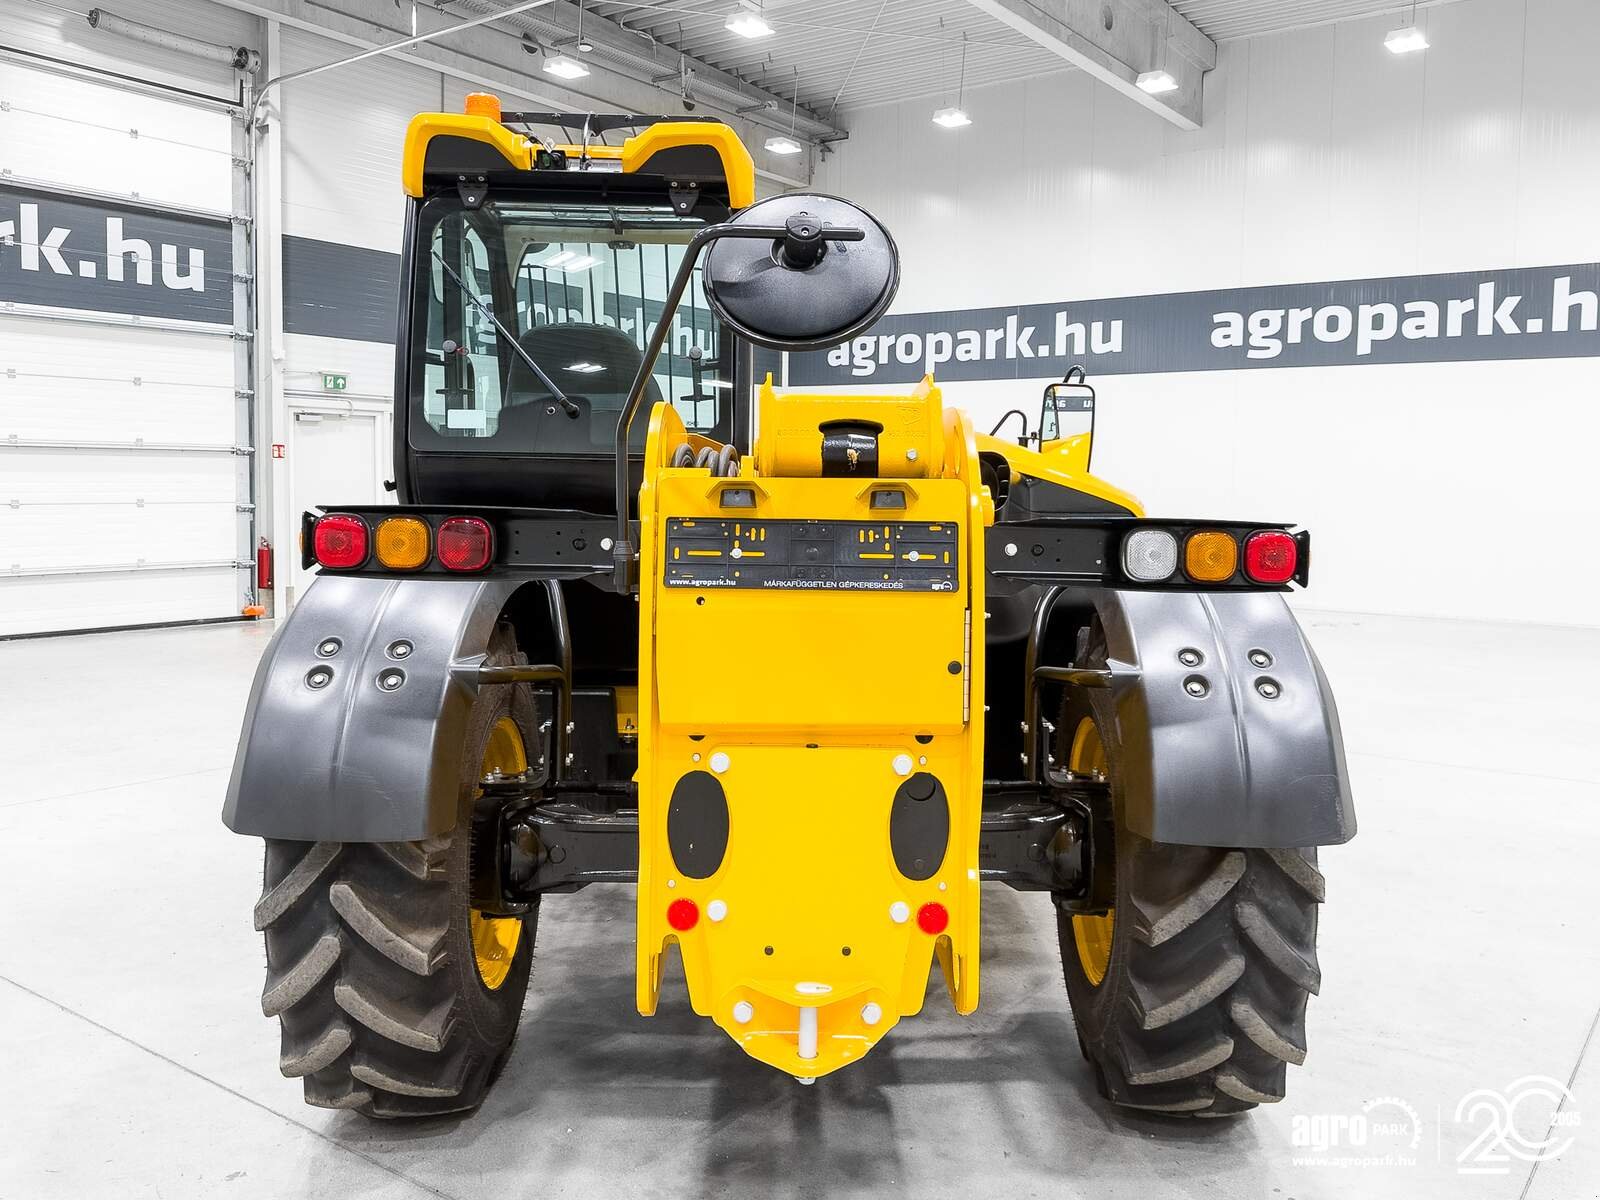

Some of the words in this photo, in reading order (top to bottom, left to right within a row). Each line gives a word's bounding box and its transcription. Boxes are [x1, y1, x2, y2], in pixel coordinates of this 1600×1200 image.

[827, 311, 1123, 376] agropark.hu
[669, 578, 737, 587] www.agropark.hu
[763, 579, 837, 588] MÁRKAFÜGGETLEN
[838, 580, 904, 589] GÉPKERESKEDÉS
